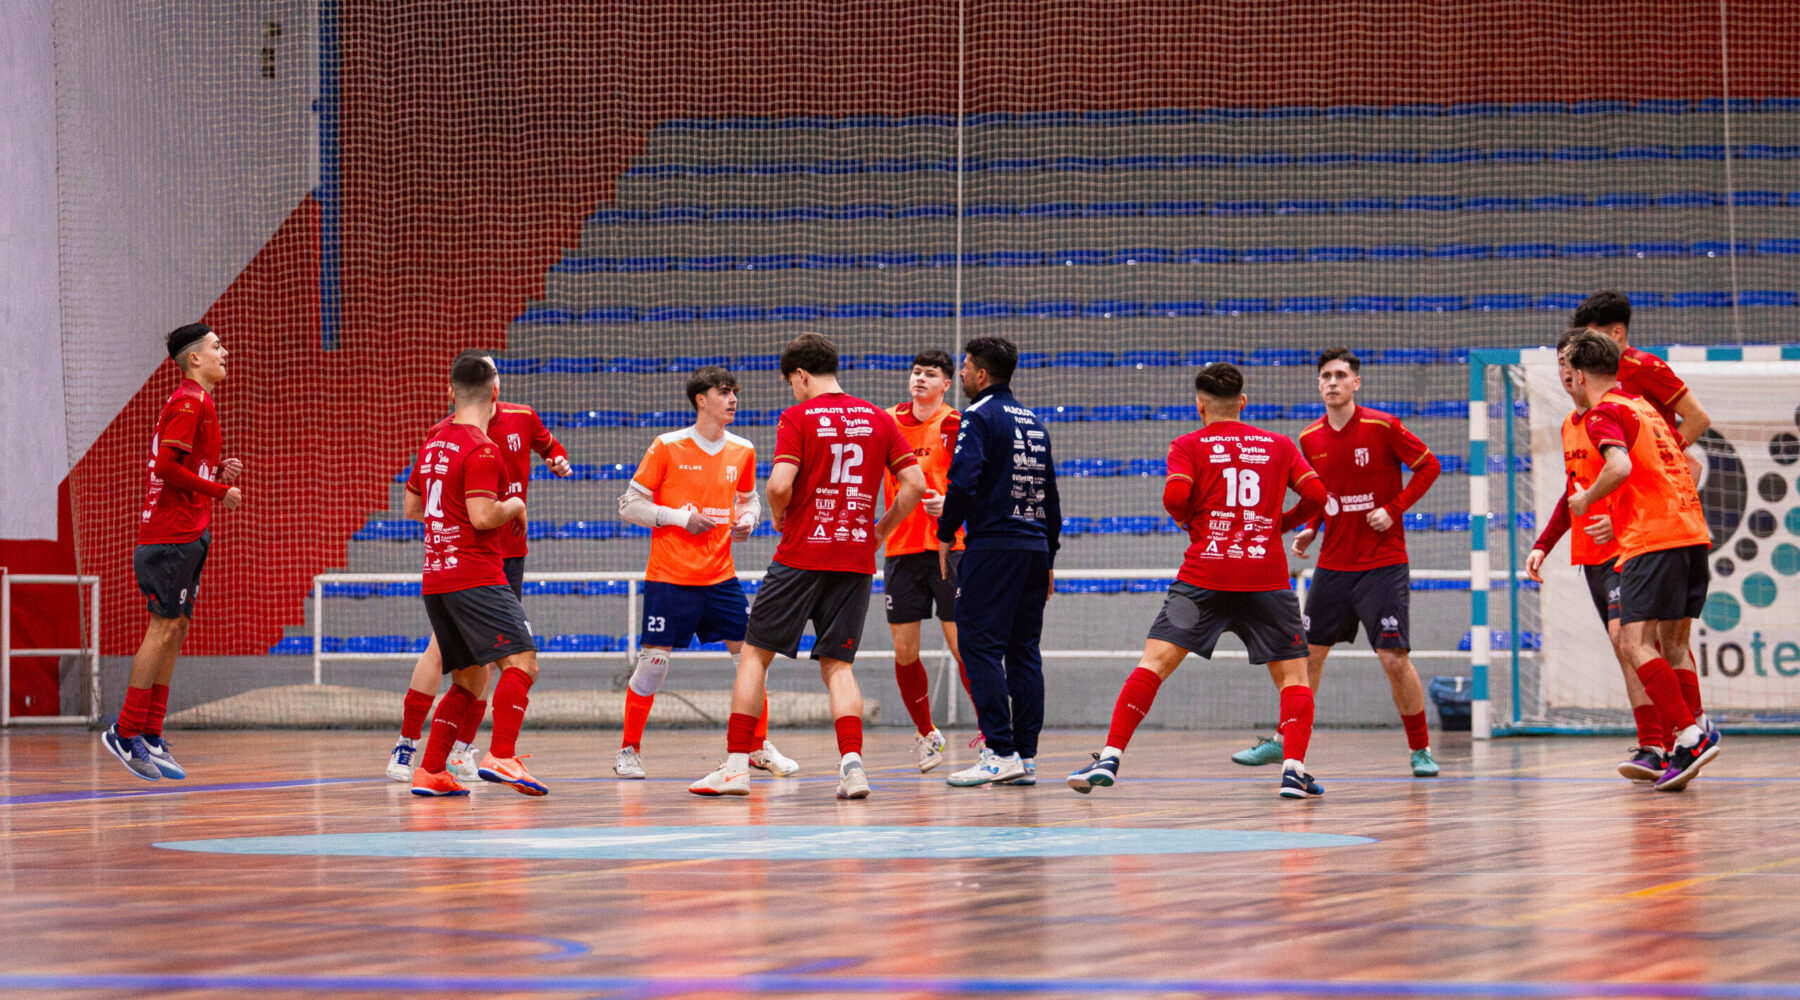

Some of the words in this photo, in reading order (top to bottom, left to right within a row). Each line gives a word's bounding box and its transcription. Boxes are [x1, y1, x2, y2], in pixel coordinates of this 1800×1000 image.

[805, 407, 844, 415] ALBOLOTE
[846, 406, 875, 415] FUTSAL
[1200, 435, 1240, 443] ALBOLOTE
[1244, 435, 1275, 443] FUTSAL
[830, 443, 864, 484] 12
[1222, 467, 1260, 507] 18
[179, 588, 188, 604] 9
[647, 615, 666, 632] 23
